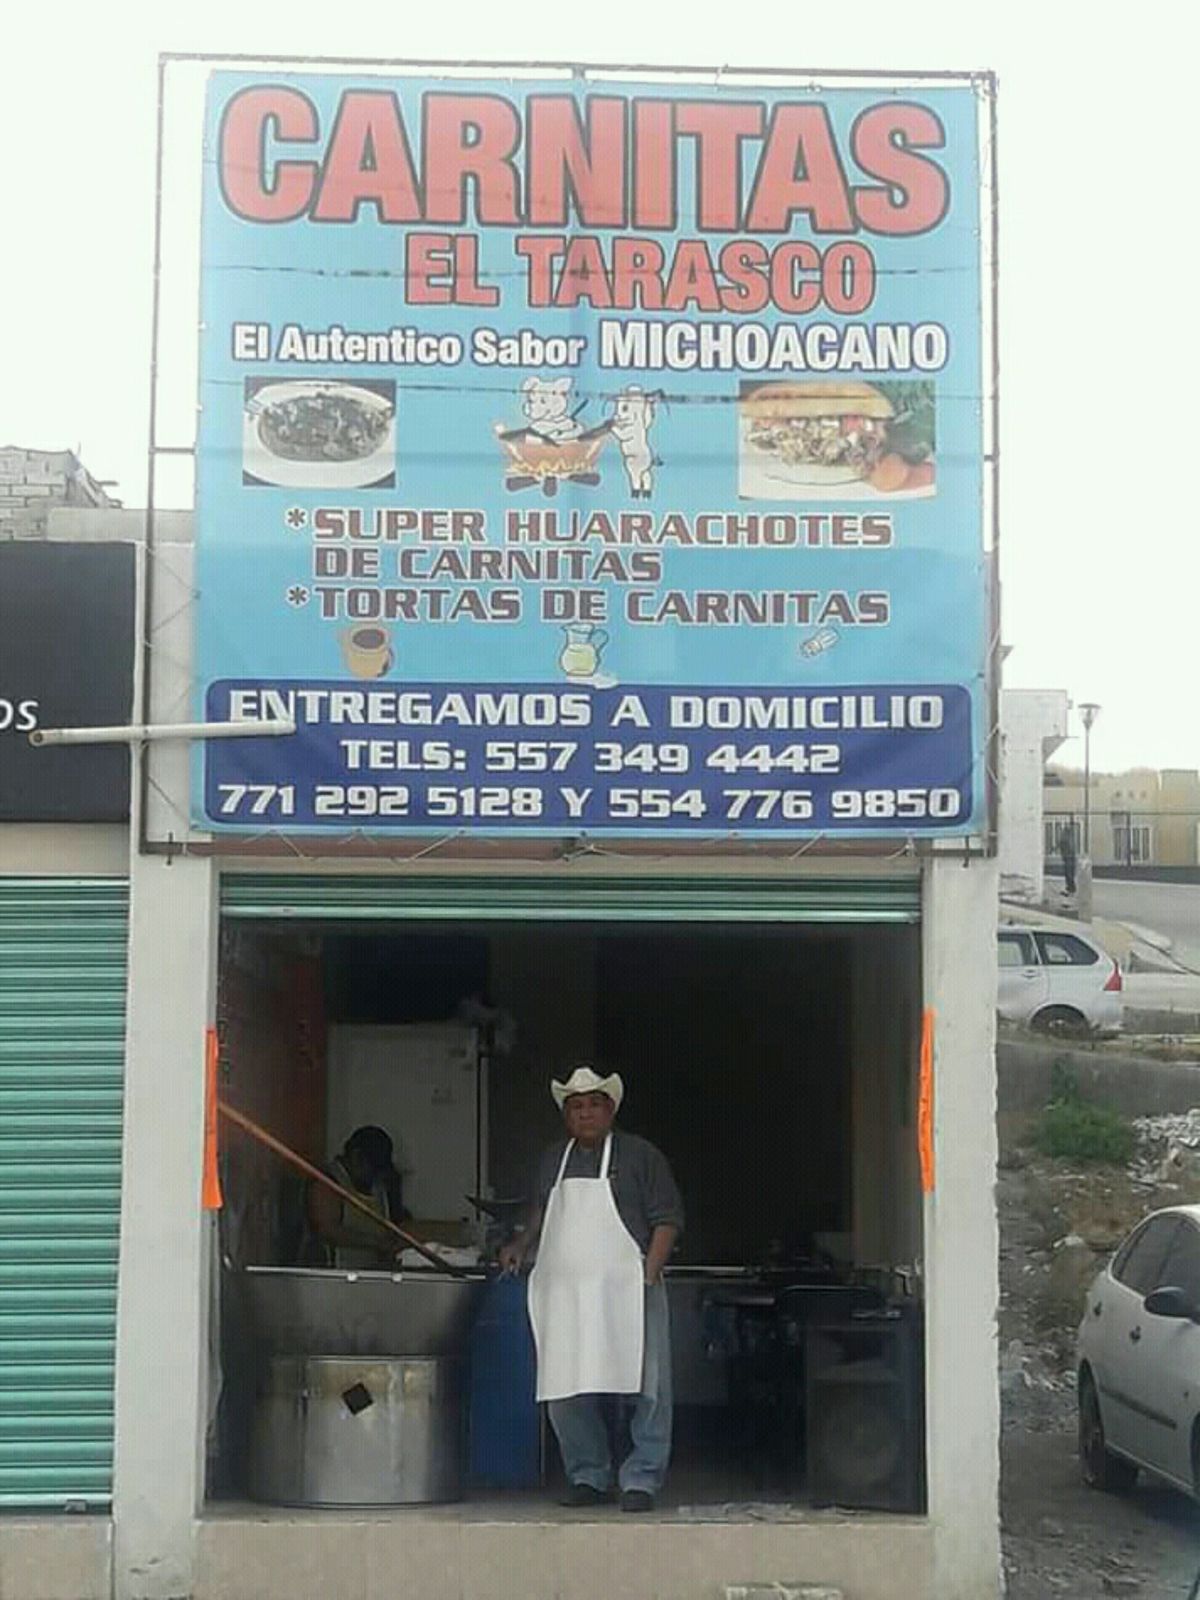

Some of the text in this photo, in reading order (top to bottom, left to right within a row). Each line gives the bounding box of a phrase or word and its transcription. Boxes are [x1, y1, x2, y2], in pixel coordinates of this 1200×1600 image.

[218, 84, 949, 238] CARNITAS
[405, 232, 876, 314] EL TARASCO
[233, 320, 949, 371] El Autentico Sabor MICHOACANO
[507, 510, 892, 546] HUARACHOTES
[314, 547, 662, 582] DE CARNITAS
[542, 589, 607, 621] DE
[626, 591, 890, 624] CARNITAS
[229, 690, 944, 729] ENTREGAMOS A DOMICILIO
[340, 740, 841, 774] TELS: 557 349 4442
[218, 785, 960, 819] 771 292 5128 Y 554 776 9850
